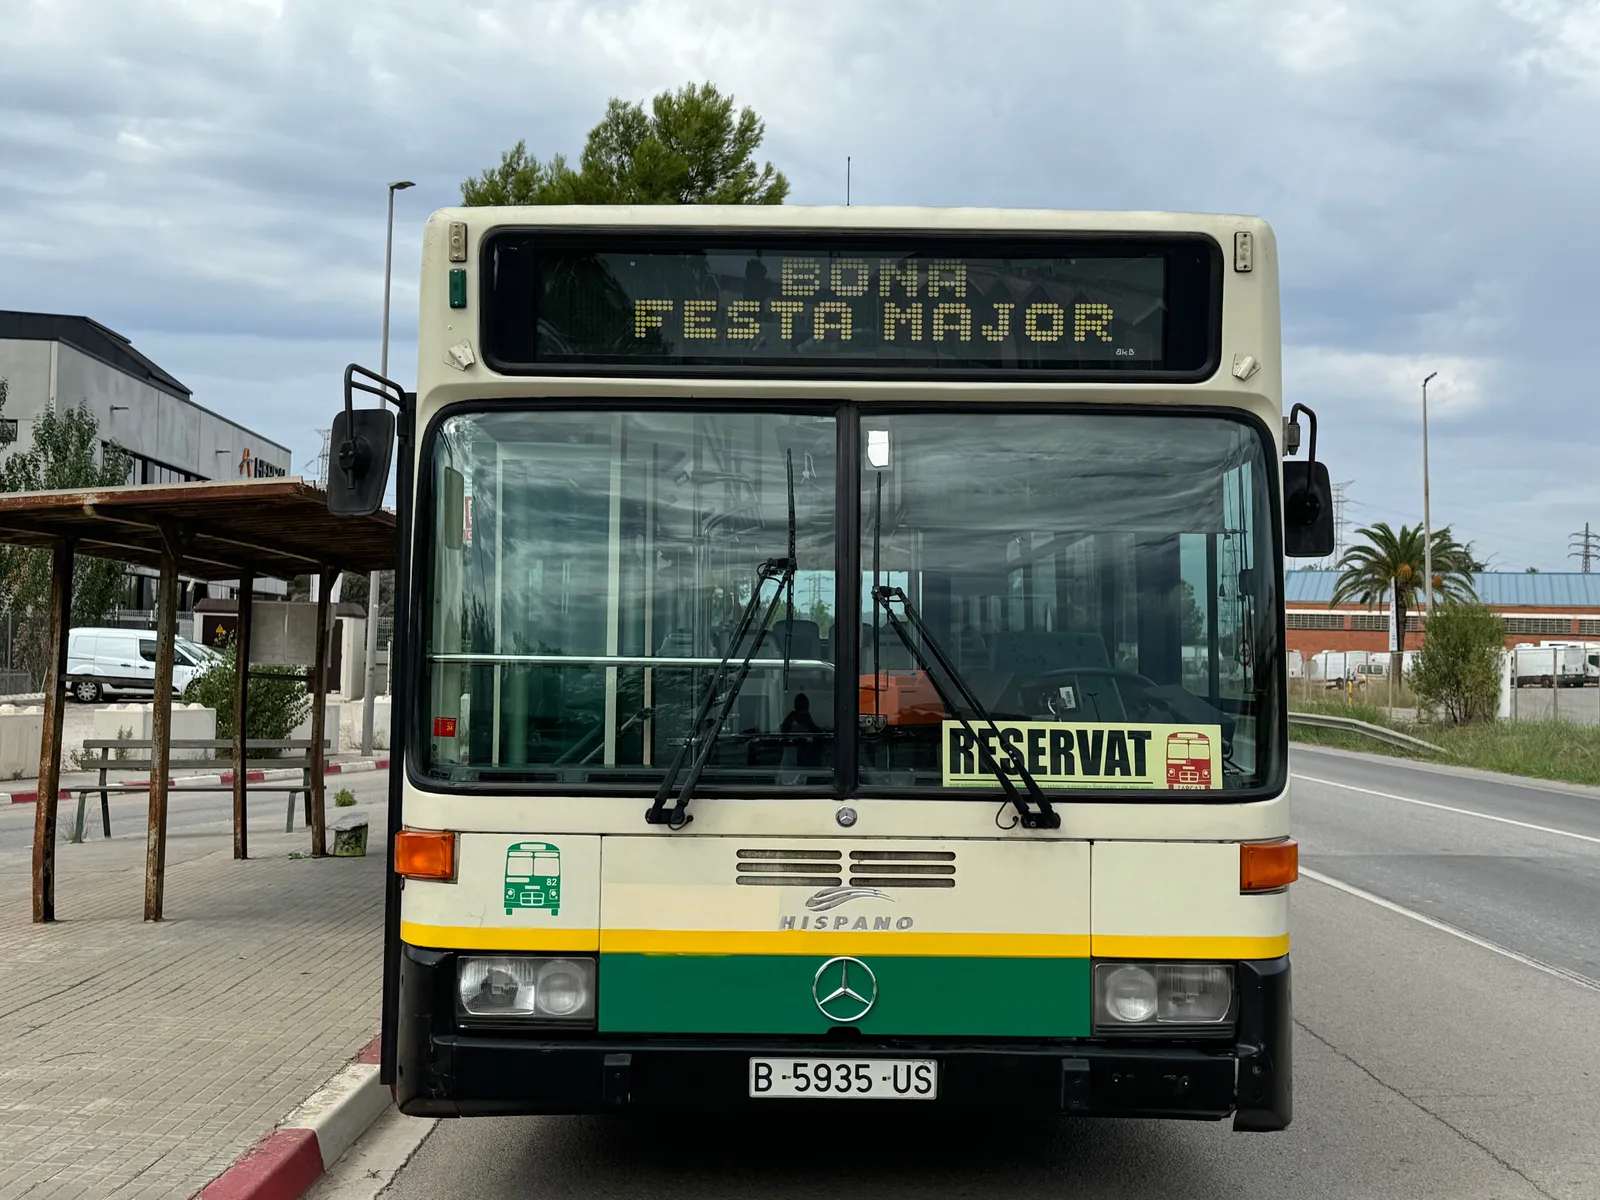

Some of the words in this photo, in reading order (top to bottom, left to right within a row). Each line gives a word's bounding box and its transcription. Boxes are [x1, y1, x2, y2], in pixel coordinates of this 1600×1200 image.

[781, 258, 966, 297] BONA
[634, 300, 852, 340] FESTA
[883, 301, 1114, 343] MAJOR
[950, 728, 1152, 776] RESERVAT
[546, 877, 558, 887] 82
[780, 916, 913, 930] HISPANO
